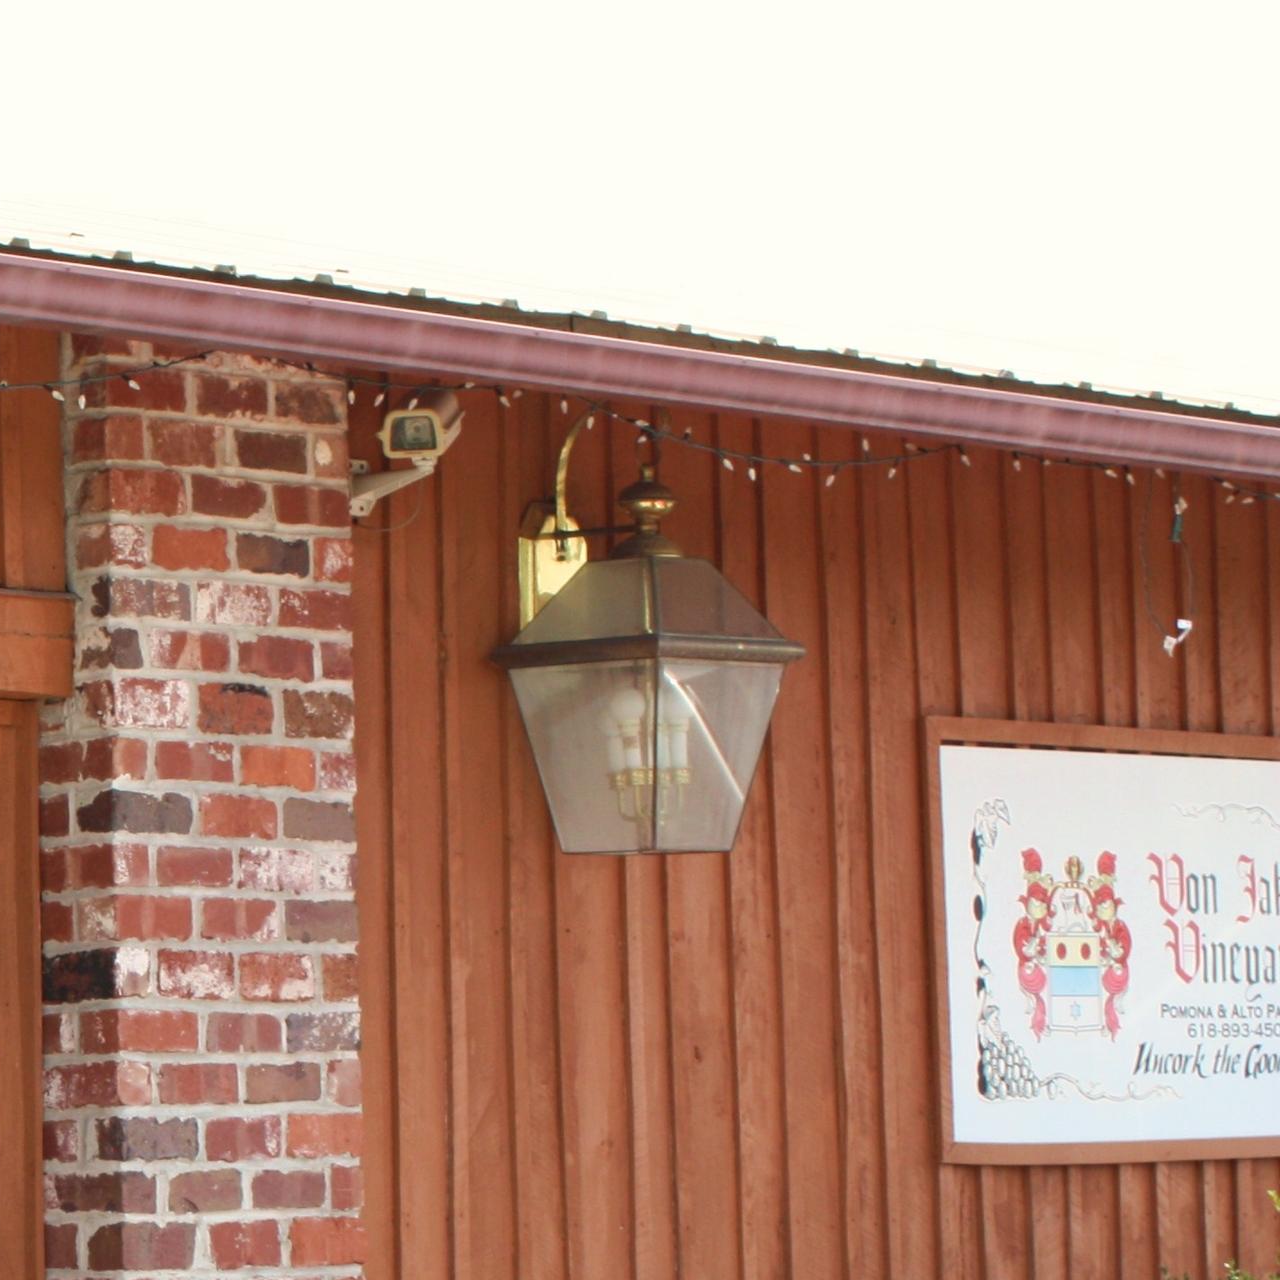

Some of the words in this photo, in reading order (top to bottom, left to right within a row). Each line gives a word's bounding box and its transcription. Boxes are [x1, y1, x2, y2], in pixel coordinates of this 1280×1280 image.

[1146, 852, 1218, 917] Von
[1163, 919, 1280, 1002] Vineya
[1217, 1004, 1227, 1018] &
[1133, 1042, 1208, 1079] Uncork
[1213, 1044, 1241, 1074] the
